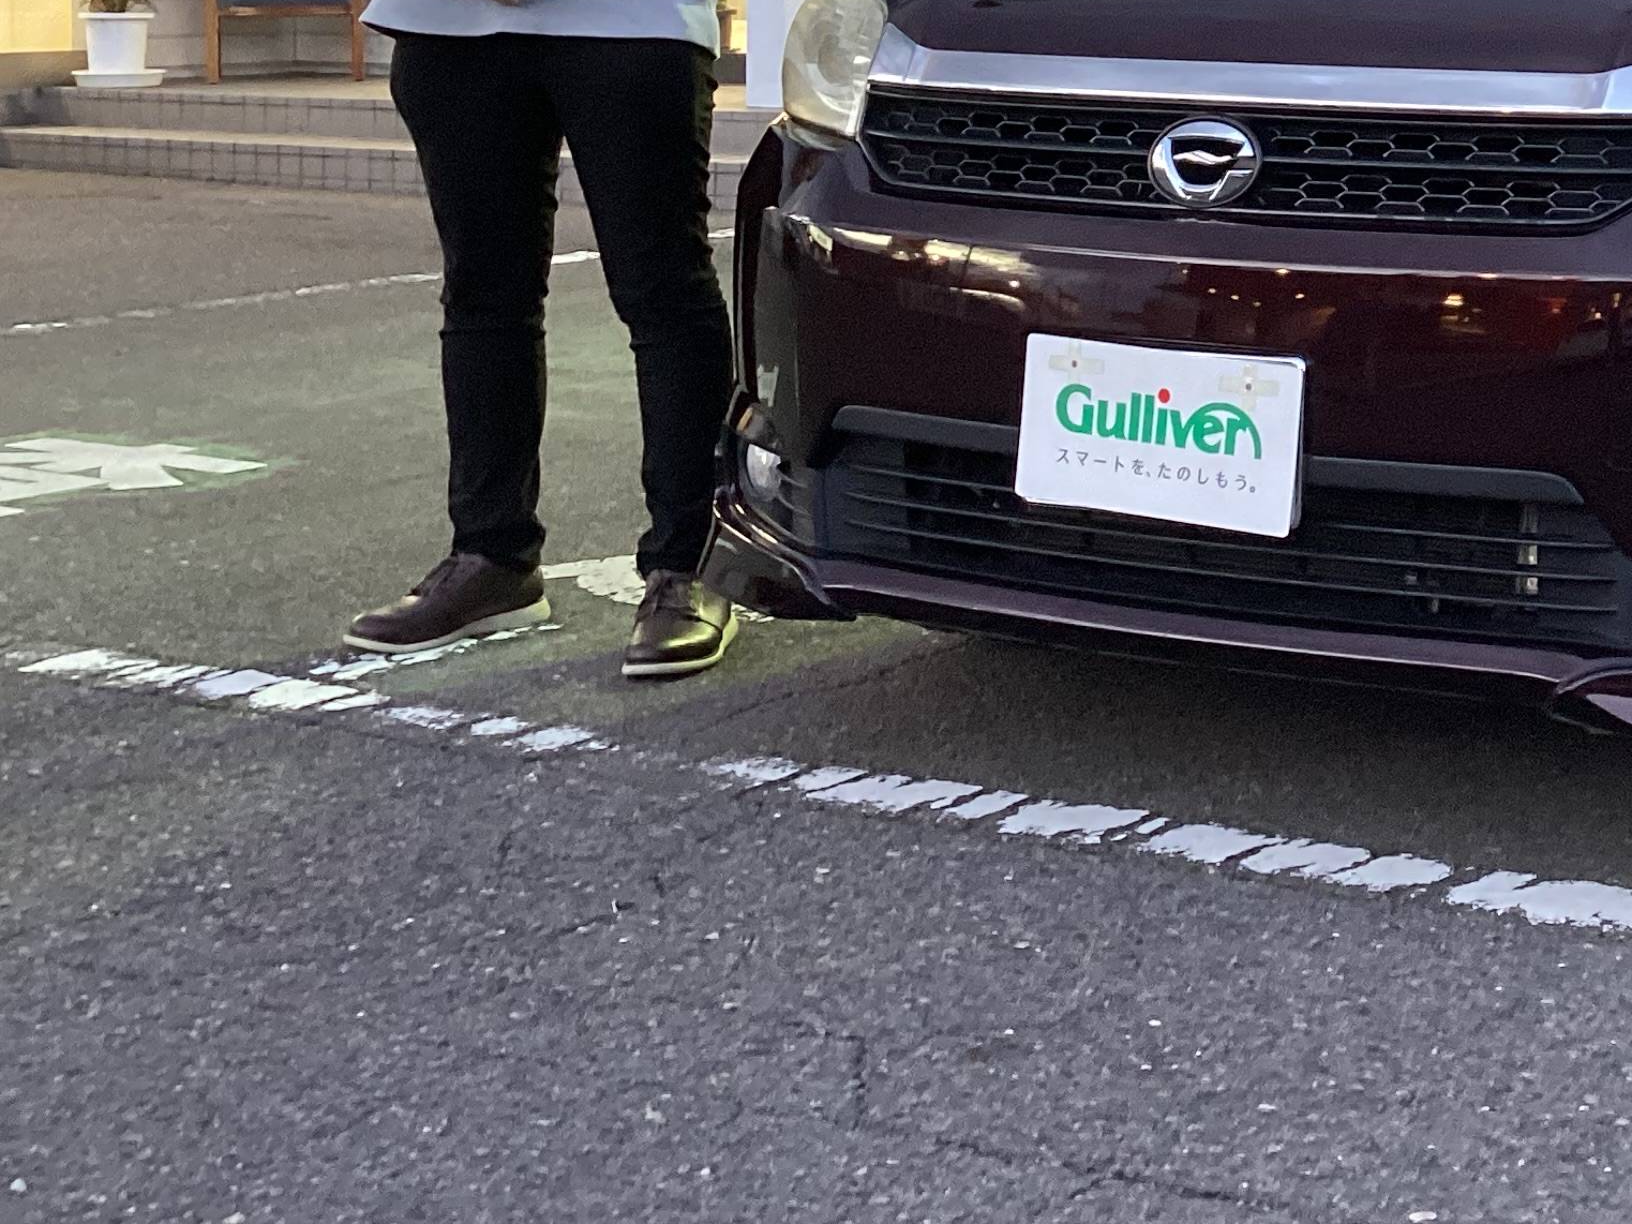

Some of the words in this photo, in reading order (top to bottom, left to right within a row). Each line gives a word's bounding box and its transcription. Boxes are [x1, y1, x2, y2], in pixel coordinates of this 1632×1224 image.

[1055, 382, 1263, 461] Gulliver
[1055, 447, 1258, 494] スマートを、たのしもう。
